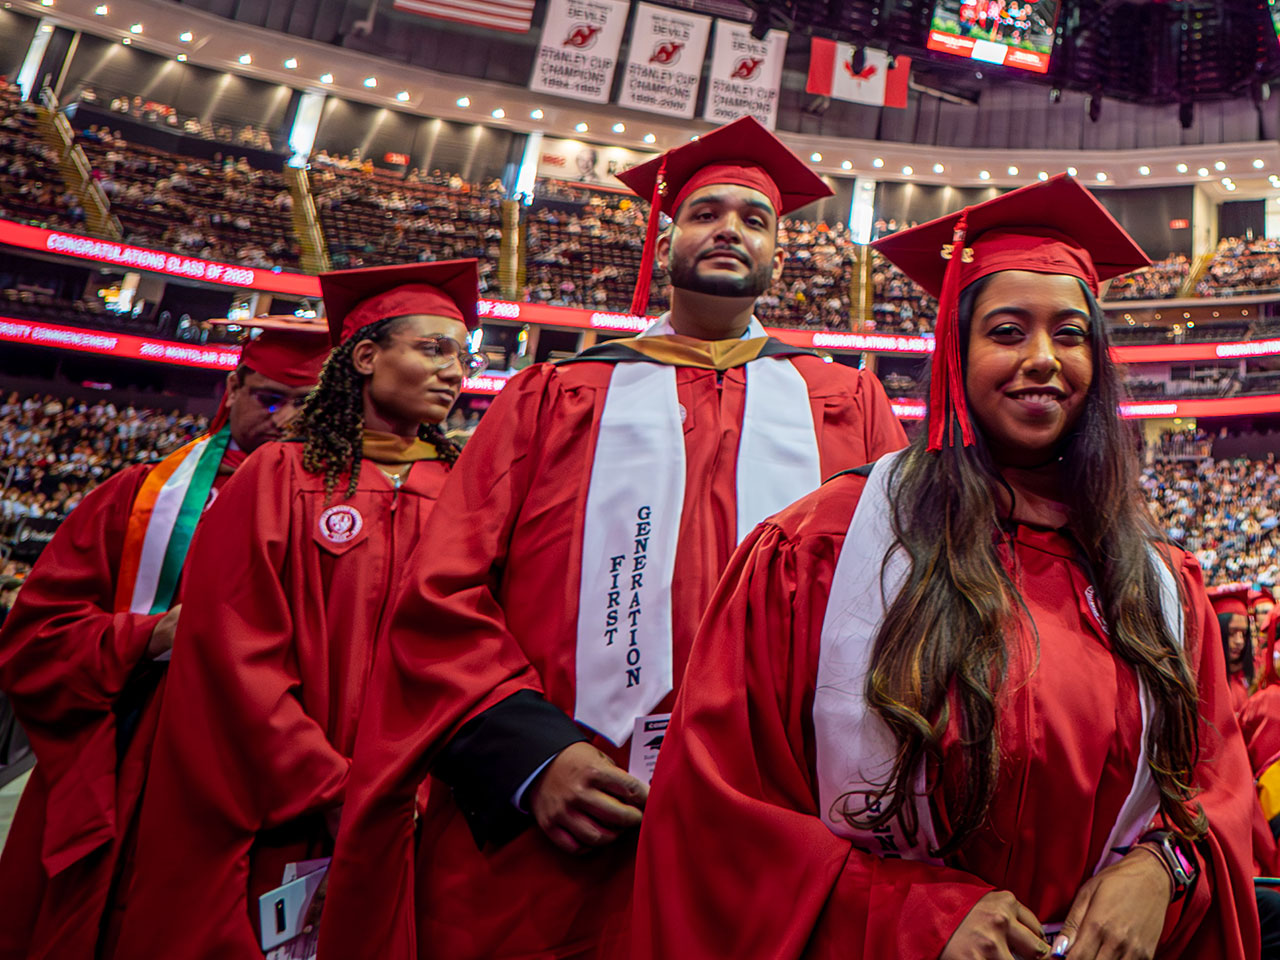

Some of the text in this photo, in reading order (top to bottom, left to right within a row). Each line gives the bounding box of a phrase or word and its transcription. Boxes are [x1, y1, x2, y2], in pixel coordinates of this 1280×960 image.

[541, 45, 613, 69] STANLEY CUP
[541, 62, 606, 85] CHAMPIONS
[629, 61, 697, 86] STANLEY CUP
[630, 79, 691, 100] CHAMPIONS
[713, 80, 777, 100] STANLEY CUP
[713, 94, 771, 114] CHAMPIONS
[47, 233, 166, 270] CONGRATULATIONS
[166, 257, 205, 277] CLASS
[205, 264, 223, 280] OF
[31, 327, 118, 350] COMMENCEMENT
[604, 554, 625, 647] FIRST
[625, 505, 652, 688] GENERATION
